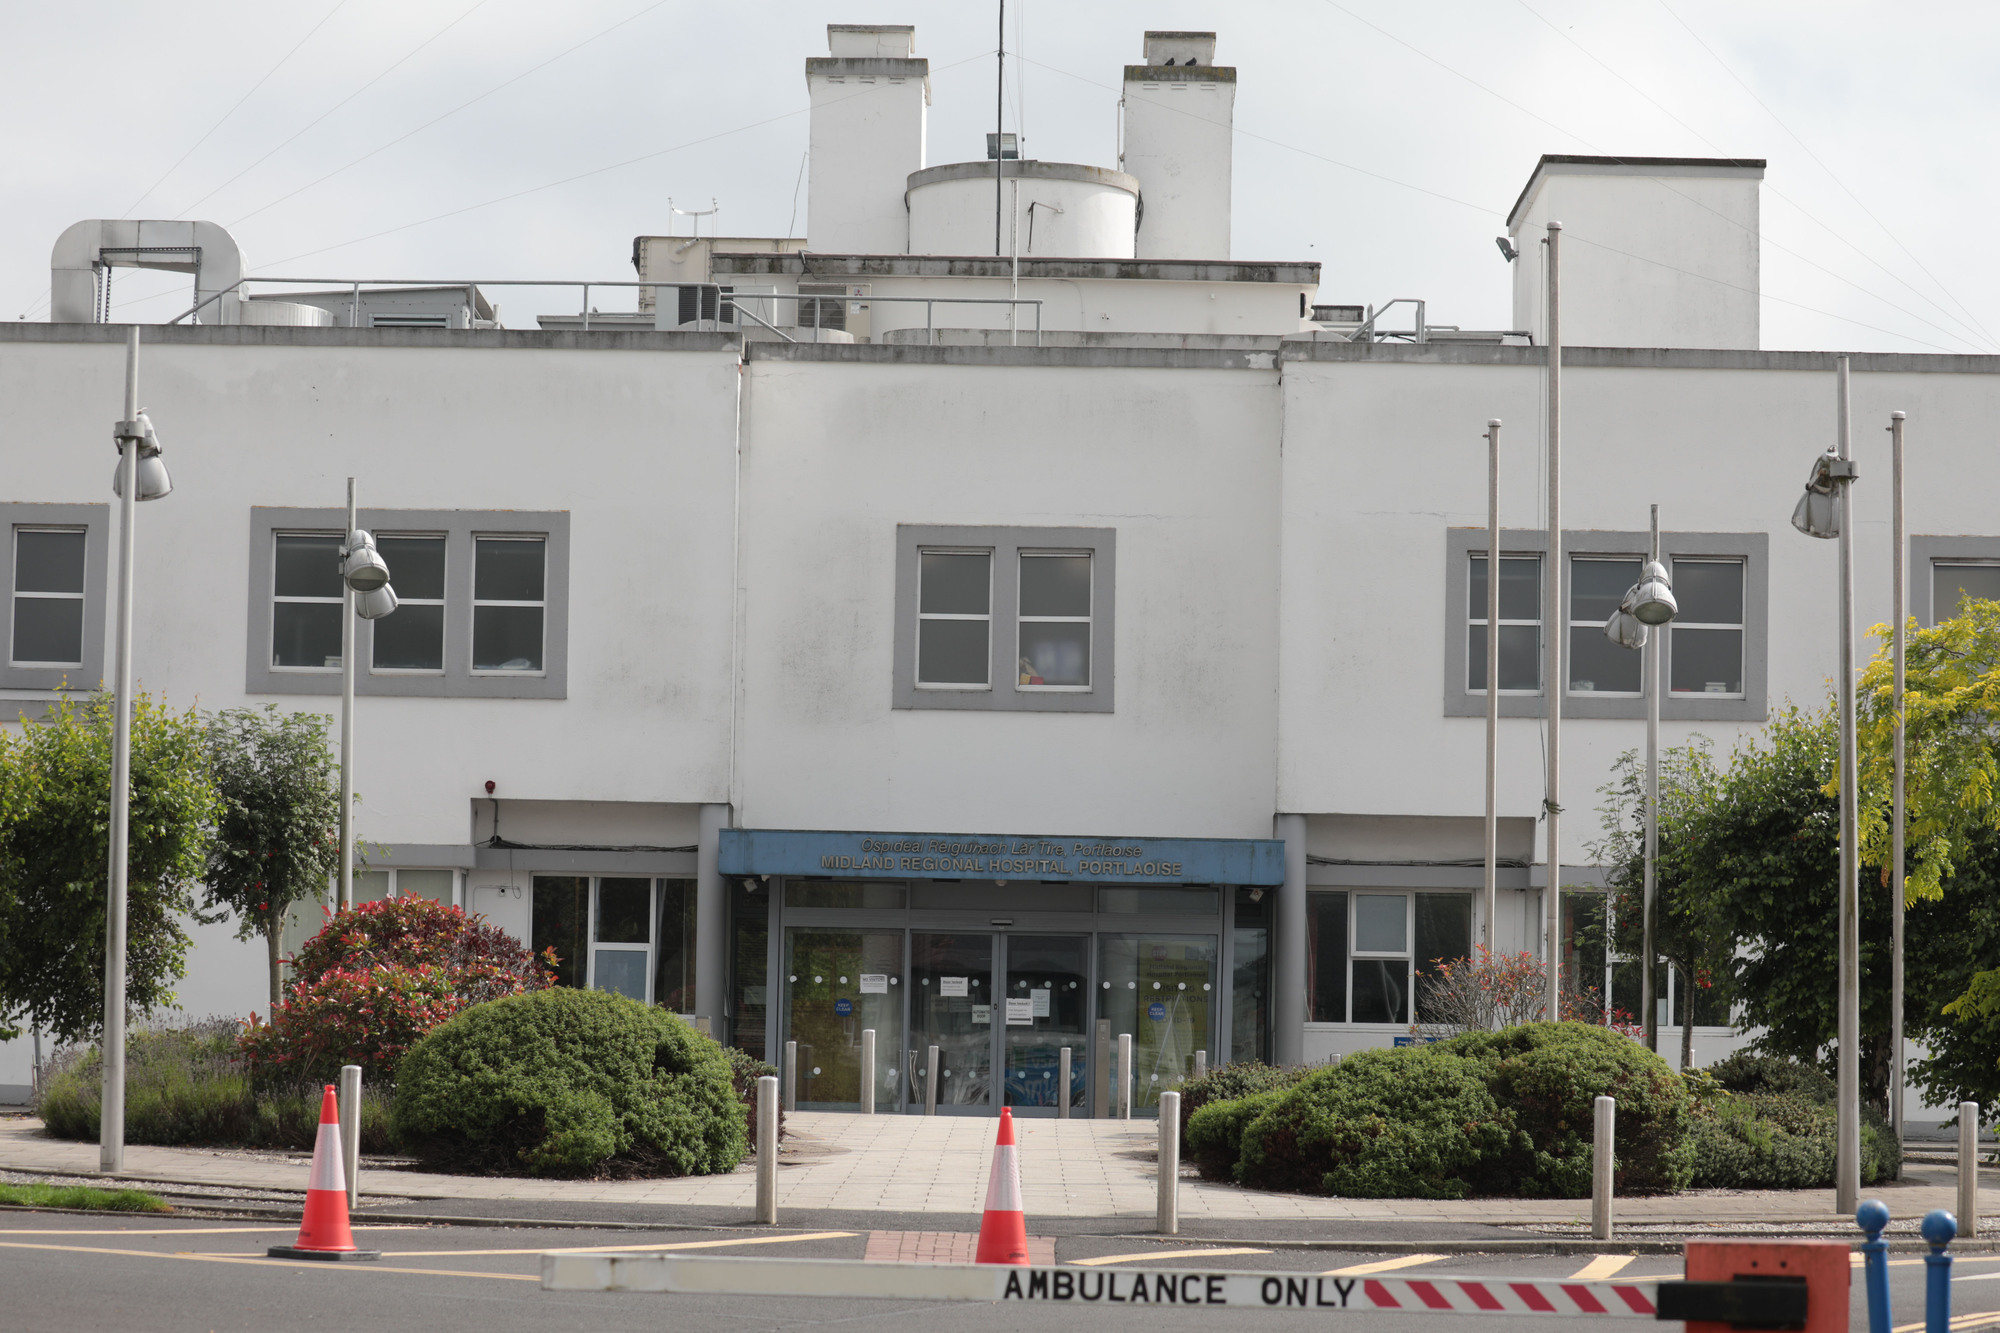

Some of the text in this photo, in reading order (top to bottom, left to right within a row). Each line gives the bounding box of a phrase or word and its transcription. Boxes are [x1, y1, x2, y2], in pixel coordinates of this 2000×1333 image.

[1072, 843, 1143, 857] Portlaoise
[821, 855, 1182, 876] MIDLAND REGIONAL HOSPITAL, PORTLAOISE
[1003, 1270, 1357, 1308] AMBULANCE ONLY
